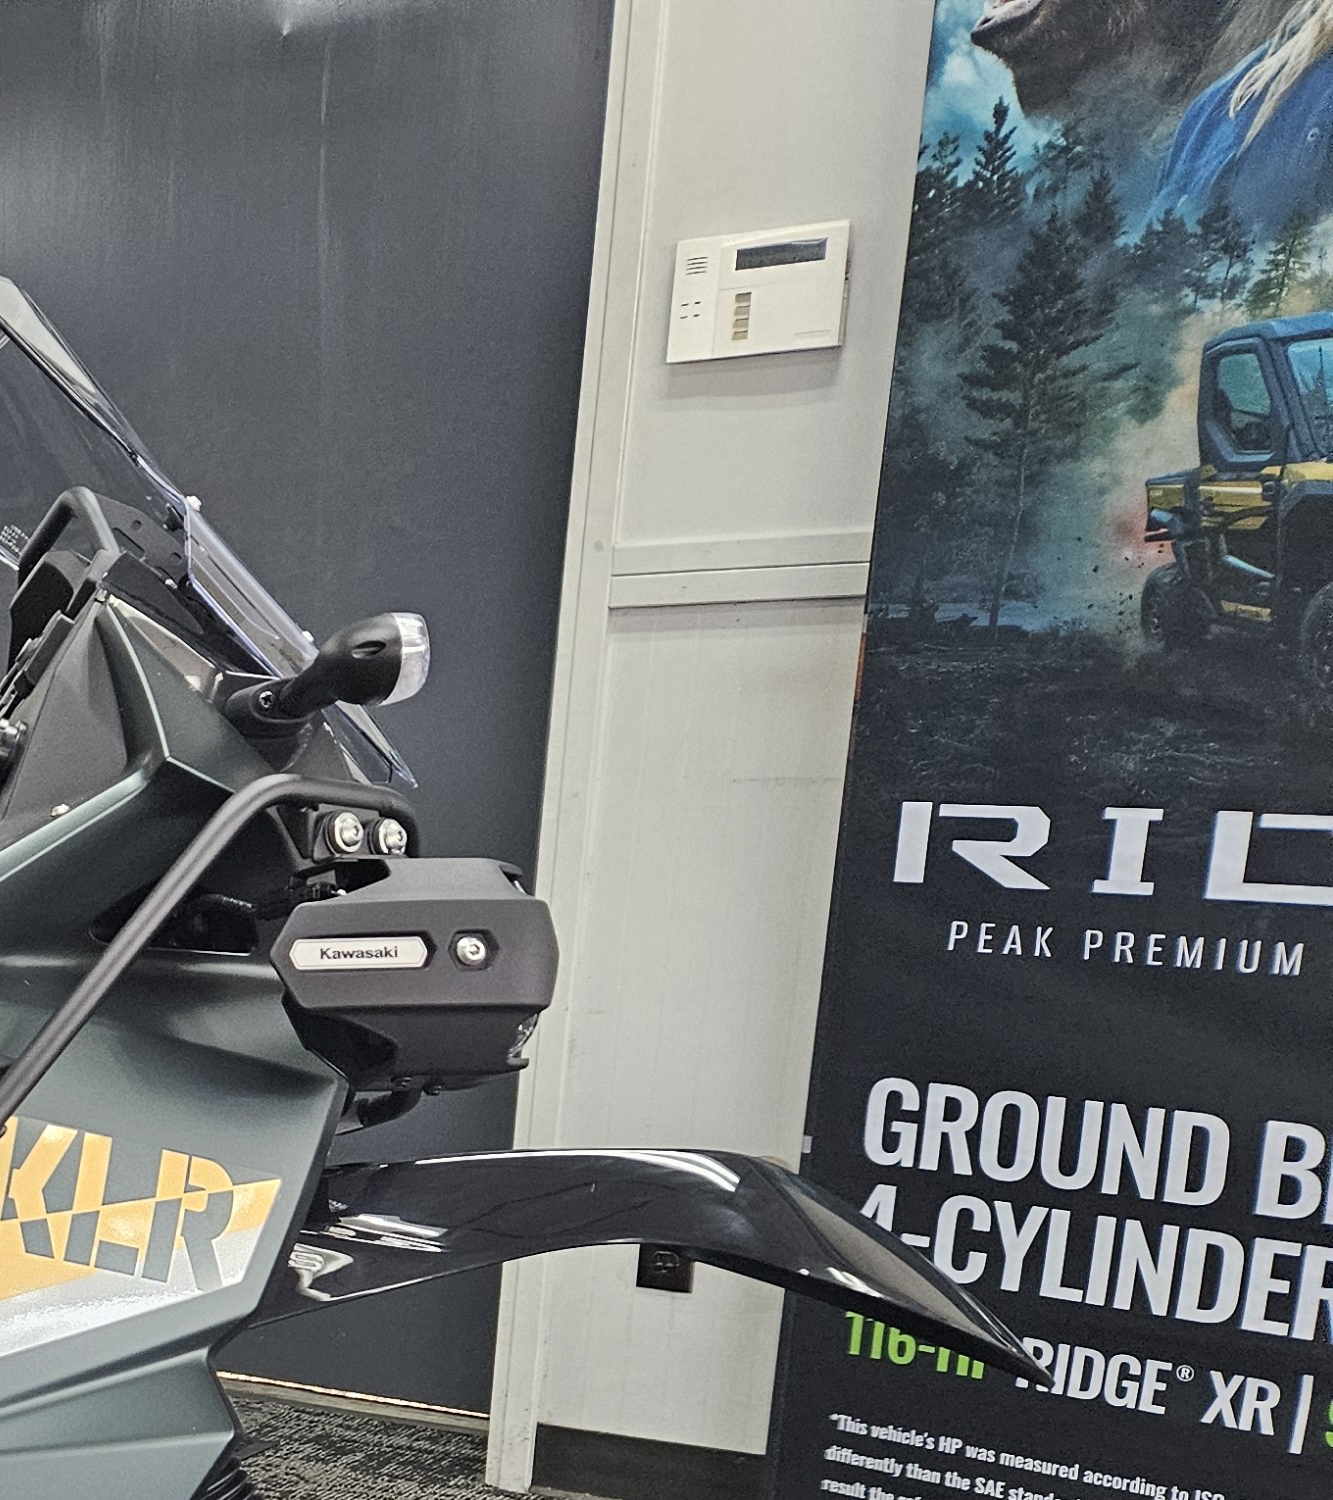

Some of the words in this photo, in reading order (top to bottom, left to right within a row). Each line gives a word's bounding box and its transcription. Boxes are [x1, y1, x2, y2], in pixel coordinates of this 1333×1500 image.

[320, 945, 399, 960] Kawasaki
[946, 920, 1054, 958] PEAK
[1082, 928, 1304, 977] PREMIUM
[863, 1076, 1230, 1207] GROUND
[1254, 1120, 1333, 1226] B
[1200, 1370, 1281, 1436] XR
[824, 1445, 904, 1478] differently
[906, 1462, 941, 1484] than
[944, 1471, 971, 1491] the
[974, 1477, 1006, 1499] SAE
[870, 1425, 935, 1450] vehicle's
[938, 1436, 963, 1455] HP
[965, 1444, 996, 1463] was
[999, 1452, 1079, 1481] measured
[820, 1478, 867, 1499] result
